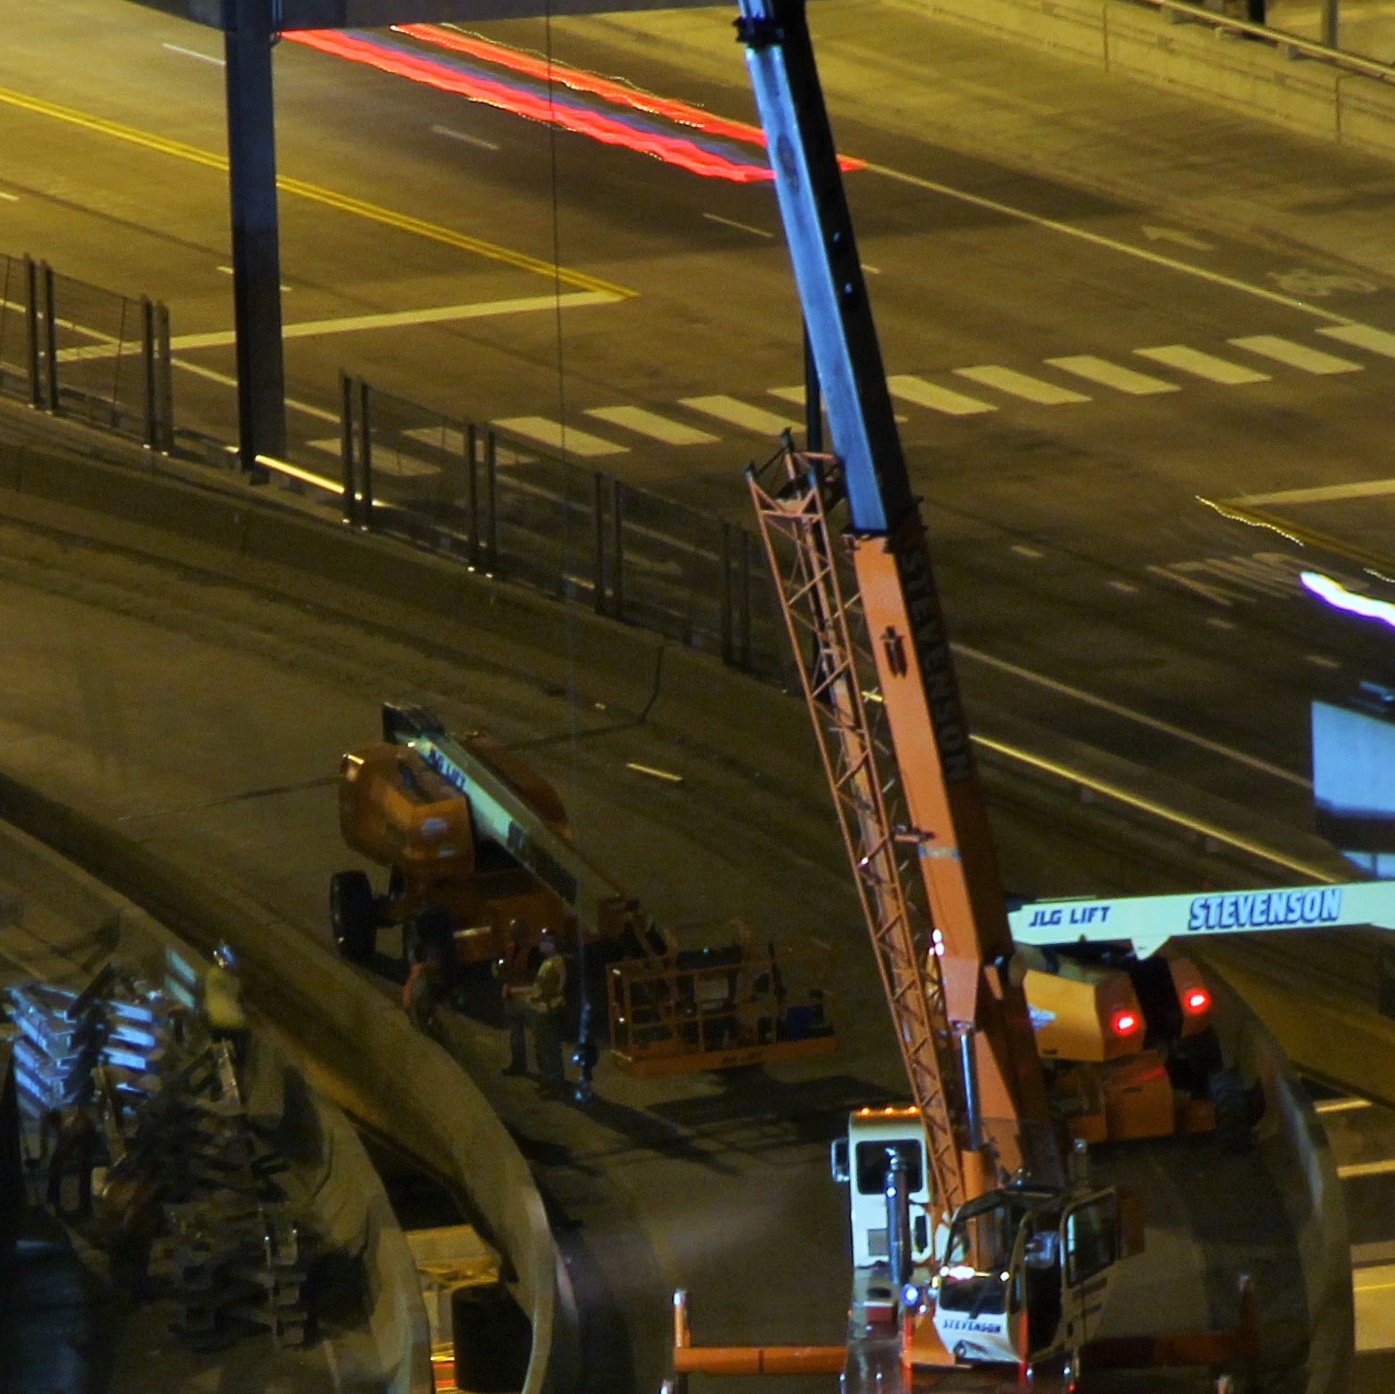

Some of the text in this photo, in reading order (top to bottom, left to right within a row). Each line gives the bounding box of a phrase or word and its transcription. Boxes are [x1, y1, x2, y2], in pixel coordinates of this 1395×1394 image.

[1029, 906, 1111, 927] JLG LIFT
[1189, 888, 1342, 930] STEVENSON
[944, 1319, 1001, 1333] STEVENSON
